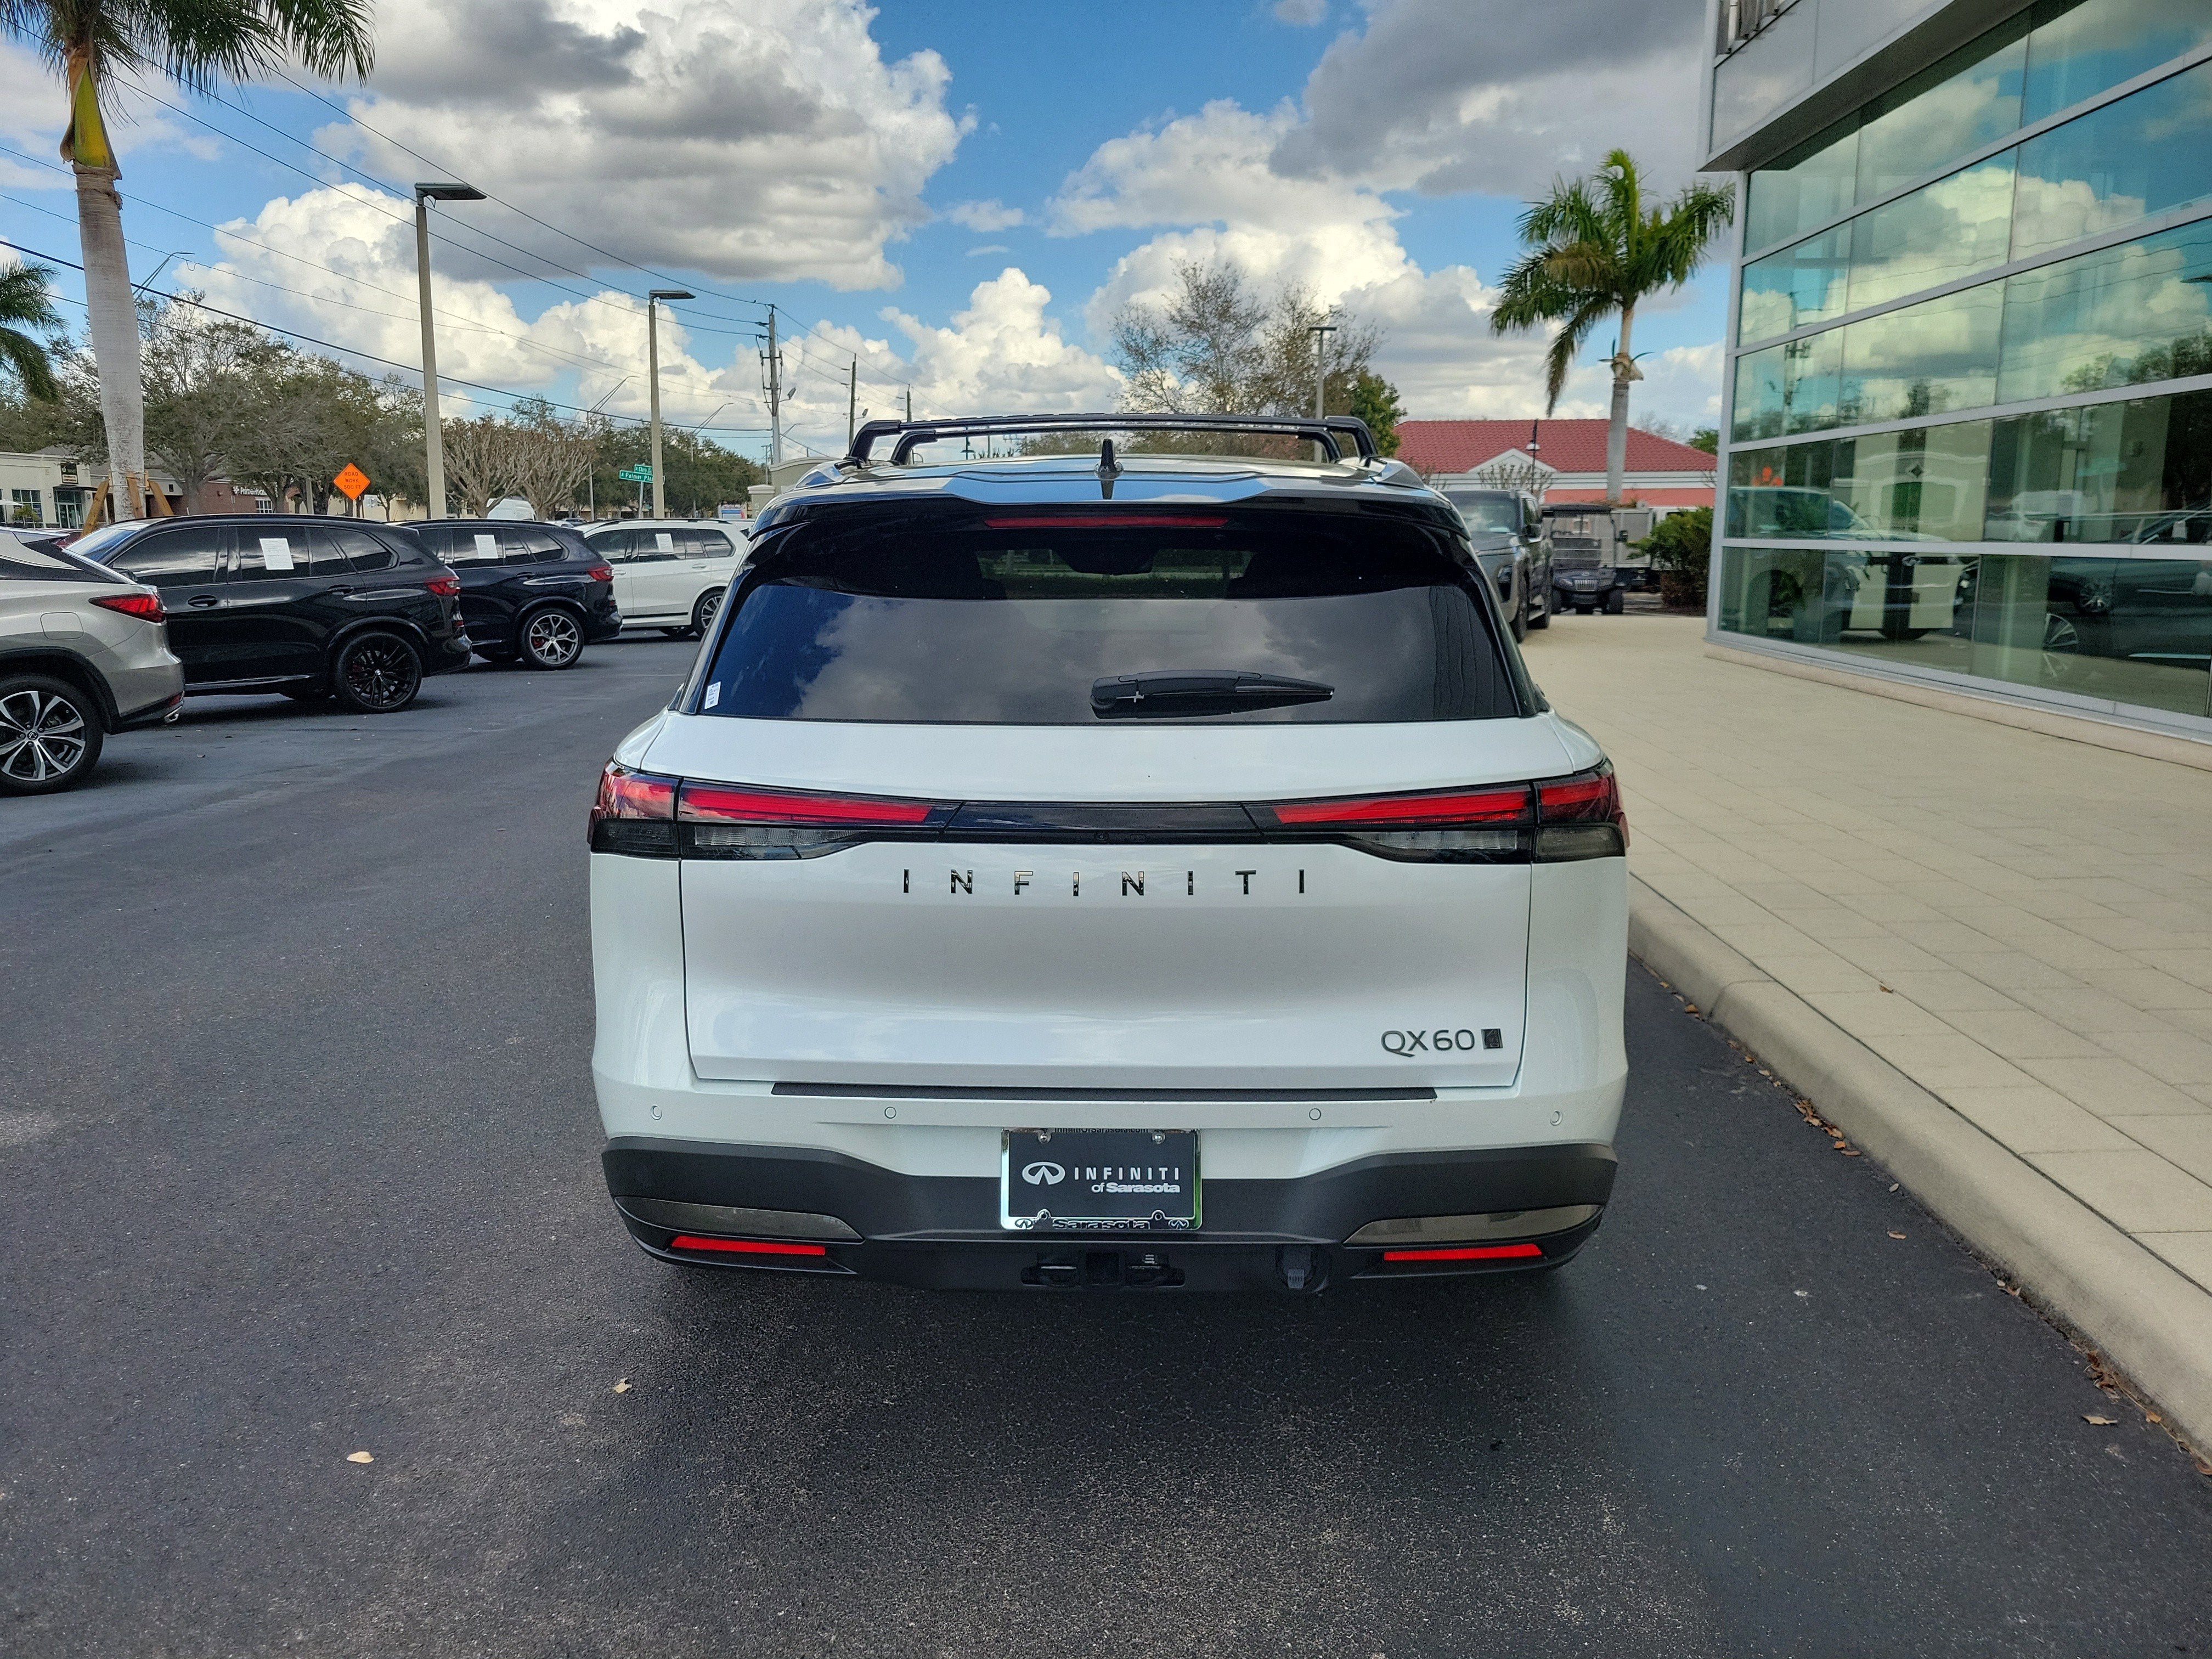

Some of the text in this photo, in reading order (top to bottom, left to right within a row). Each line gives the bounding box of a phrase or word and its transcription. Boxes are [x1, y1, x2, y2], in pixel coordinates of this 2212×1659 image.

[903, 868, 1305, 896] INFINITI
[1381, 1029, 1476, 1057] QX60
[1074, 1167, 1180, 1180] INFINITI
[1091, 1182, 1180, 1193] of Sarasota
[1052, 1218, 1151, 1229] Sarasota
